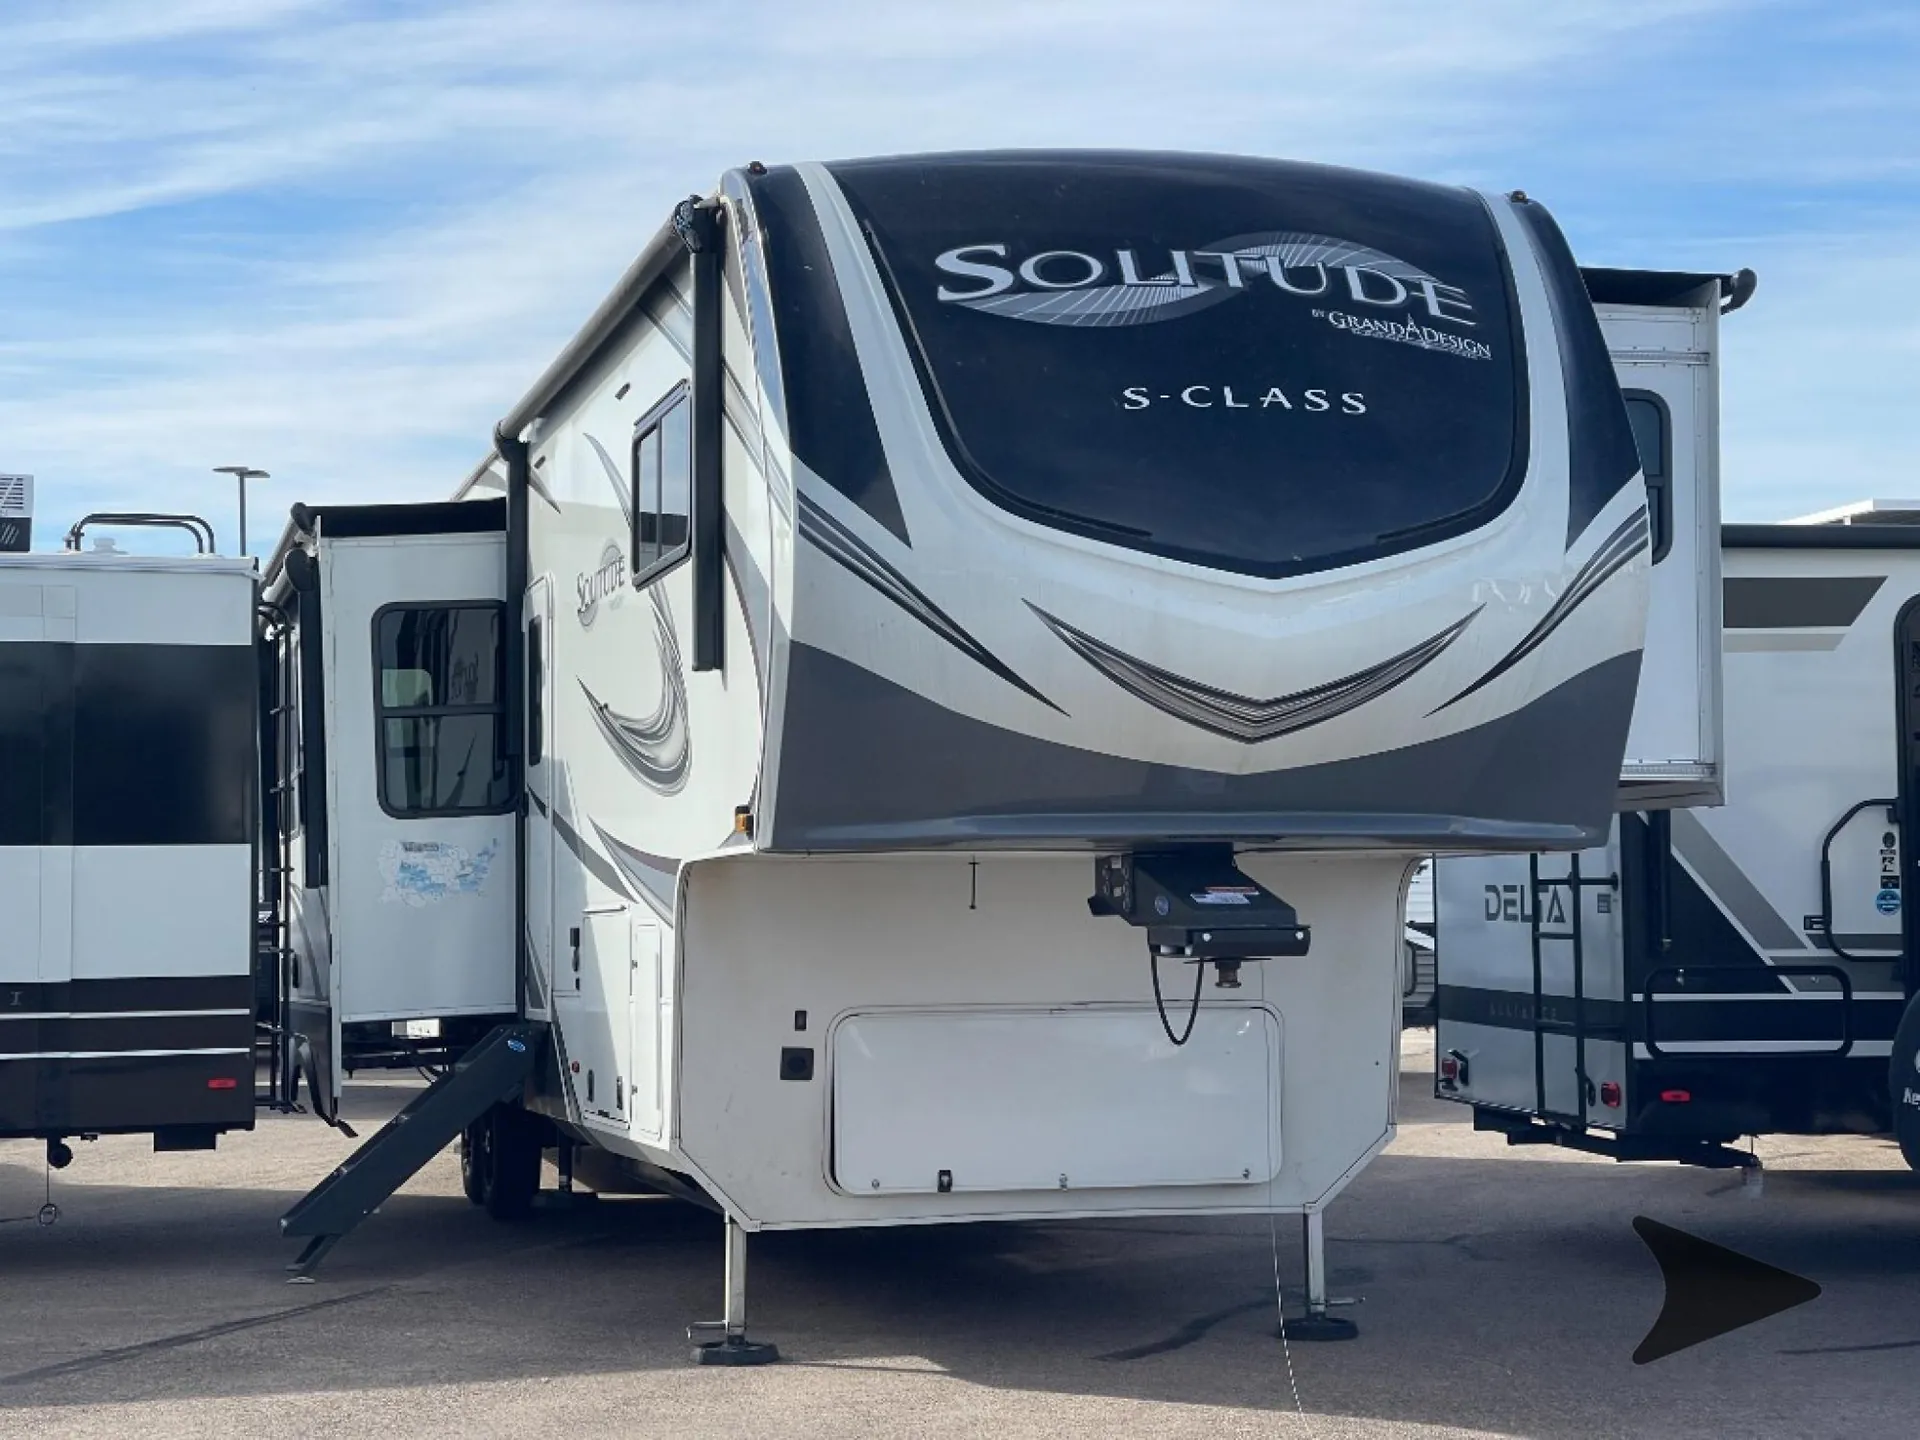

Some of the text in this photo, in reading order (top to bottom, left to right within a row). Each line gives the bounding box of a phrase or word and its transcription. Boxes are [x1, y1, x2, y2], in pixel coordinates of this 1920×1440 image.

[934, 243, 1478, 326] SOLITUDE
[1328, 310, 1405, 337] GRAND
[1424, 326, 1491, 358] DESIGN
[1122, 385, 1367, 415] S-CLASS
